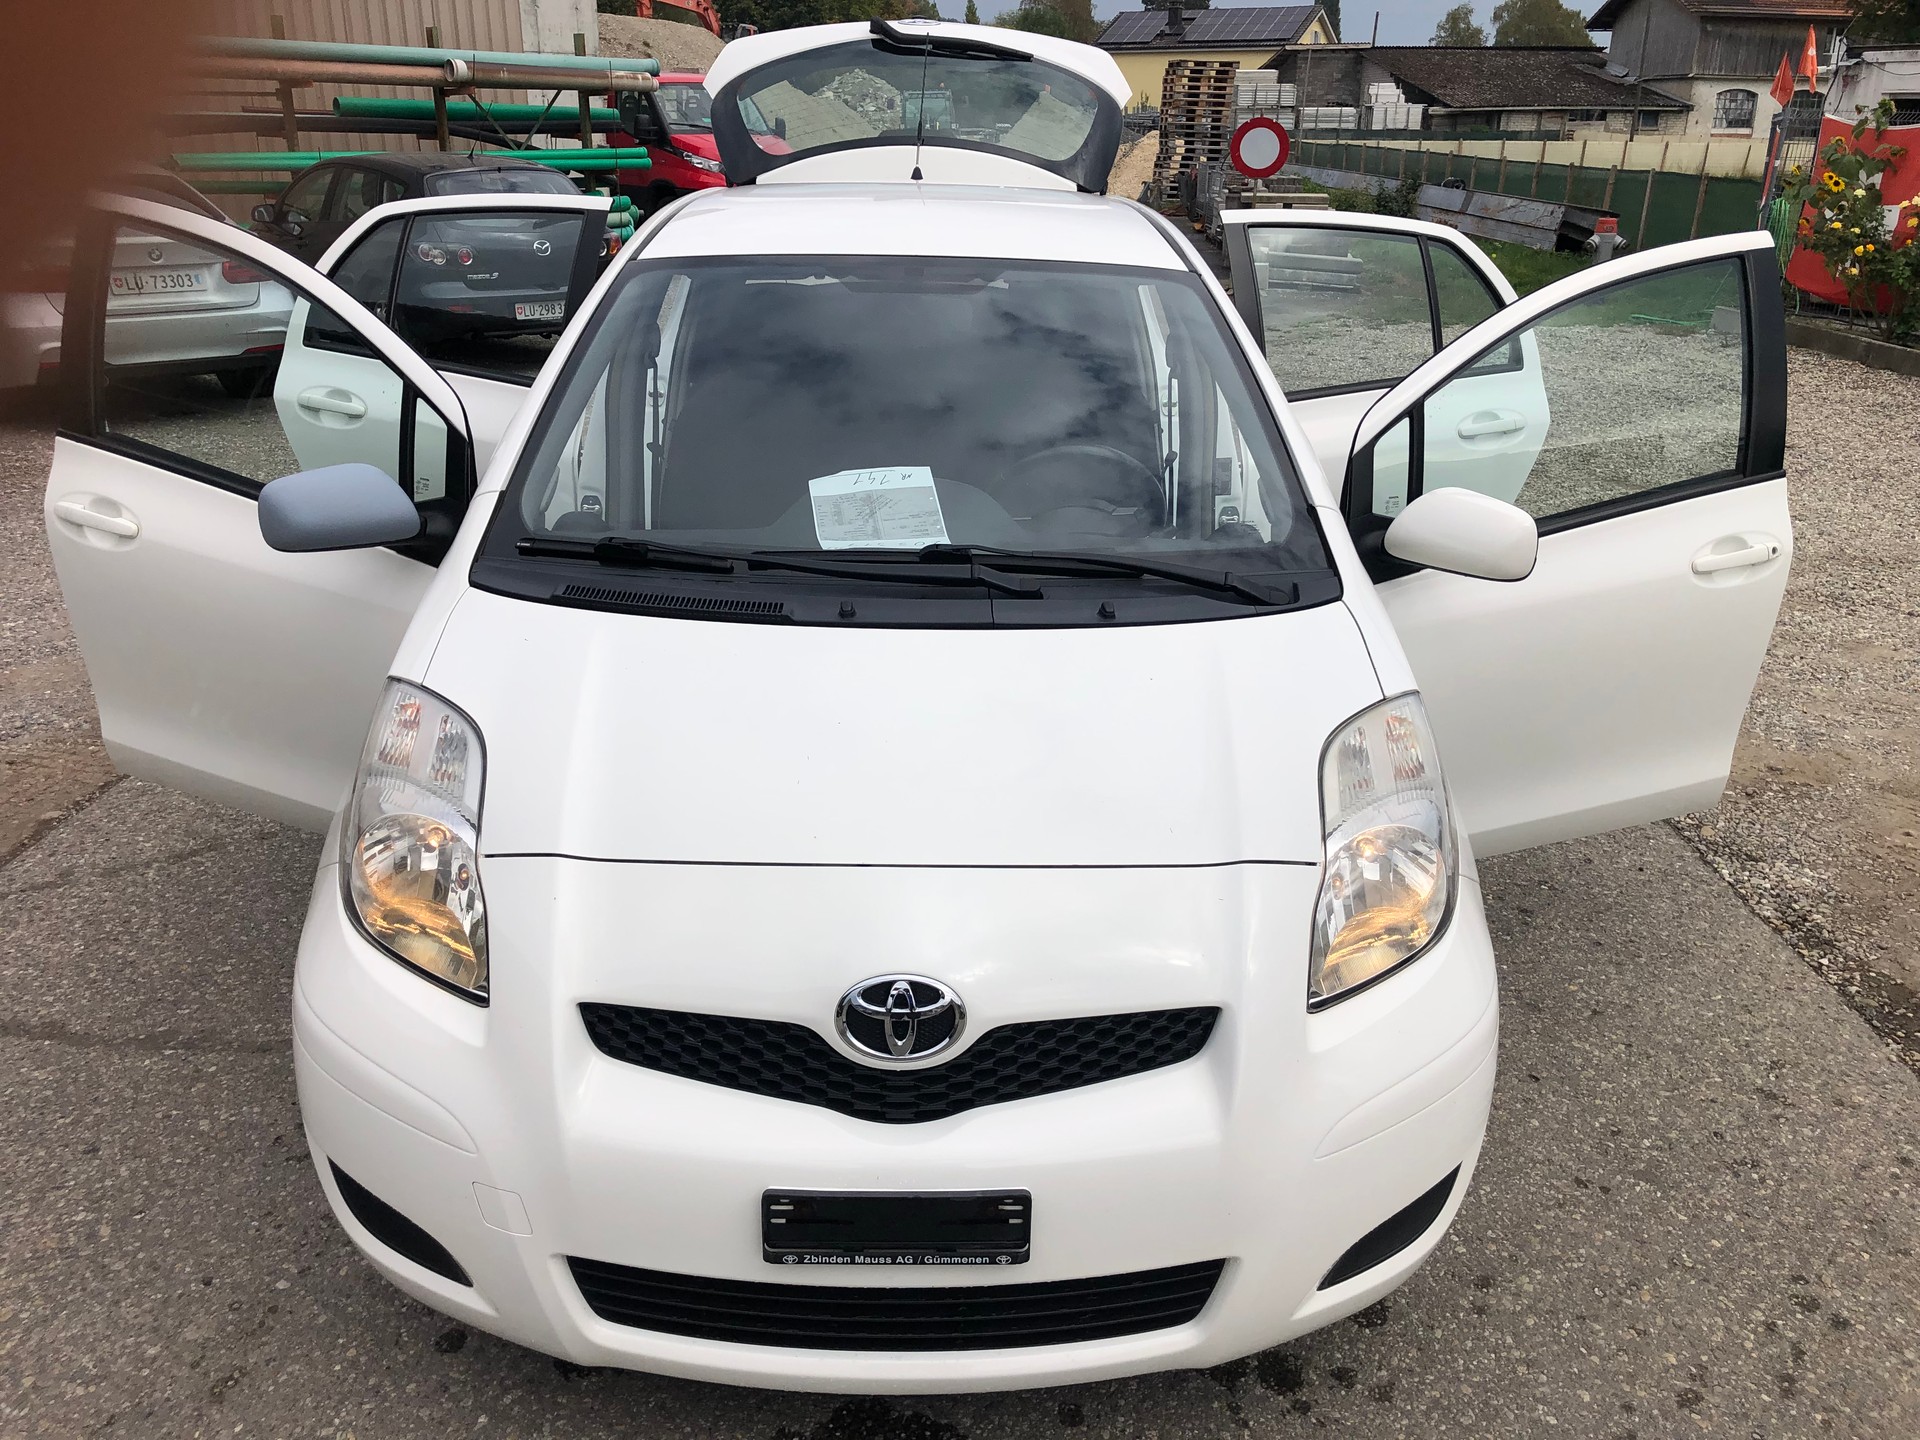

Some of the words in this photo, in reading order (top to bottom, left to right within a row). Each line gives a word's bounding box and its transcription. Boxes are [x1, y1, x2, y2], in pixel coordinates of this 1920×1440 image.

[803, 1254, 851, 1264] Zbinden
[855, 1254, 892, 1264] Mauss
[896, 1254, 913, 1264] AG
[924, 1254, 990, 1264] Gümmenen
